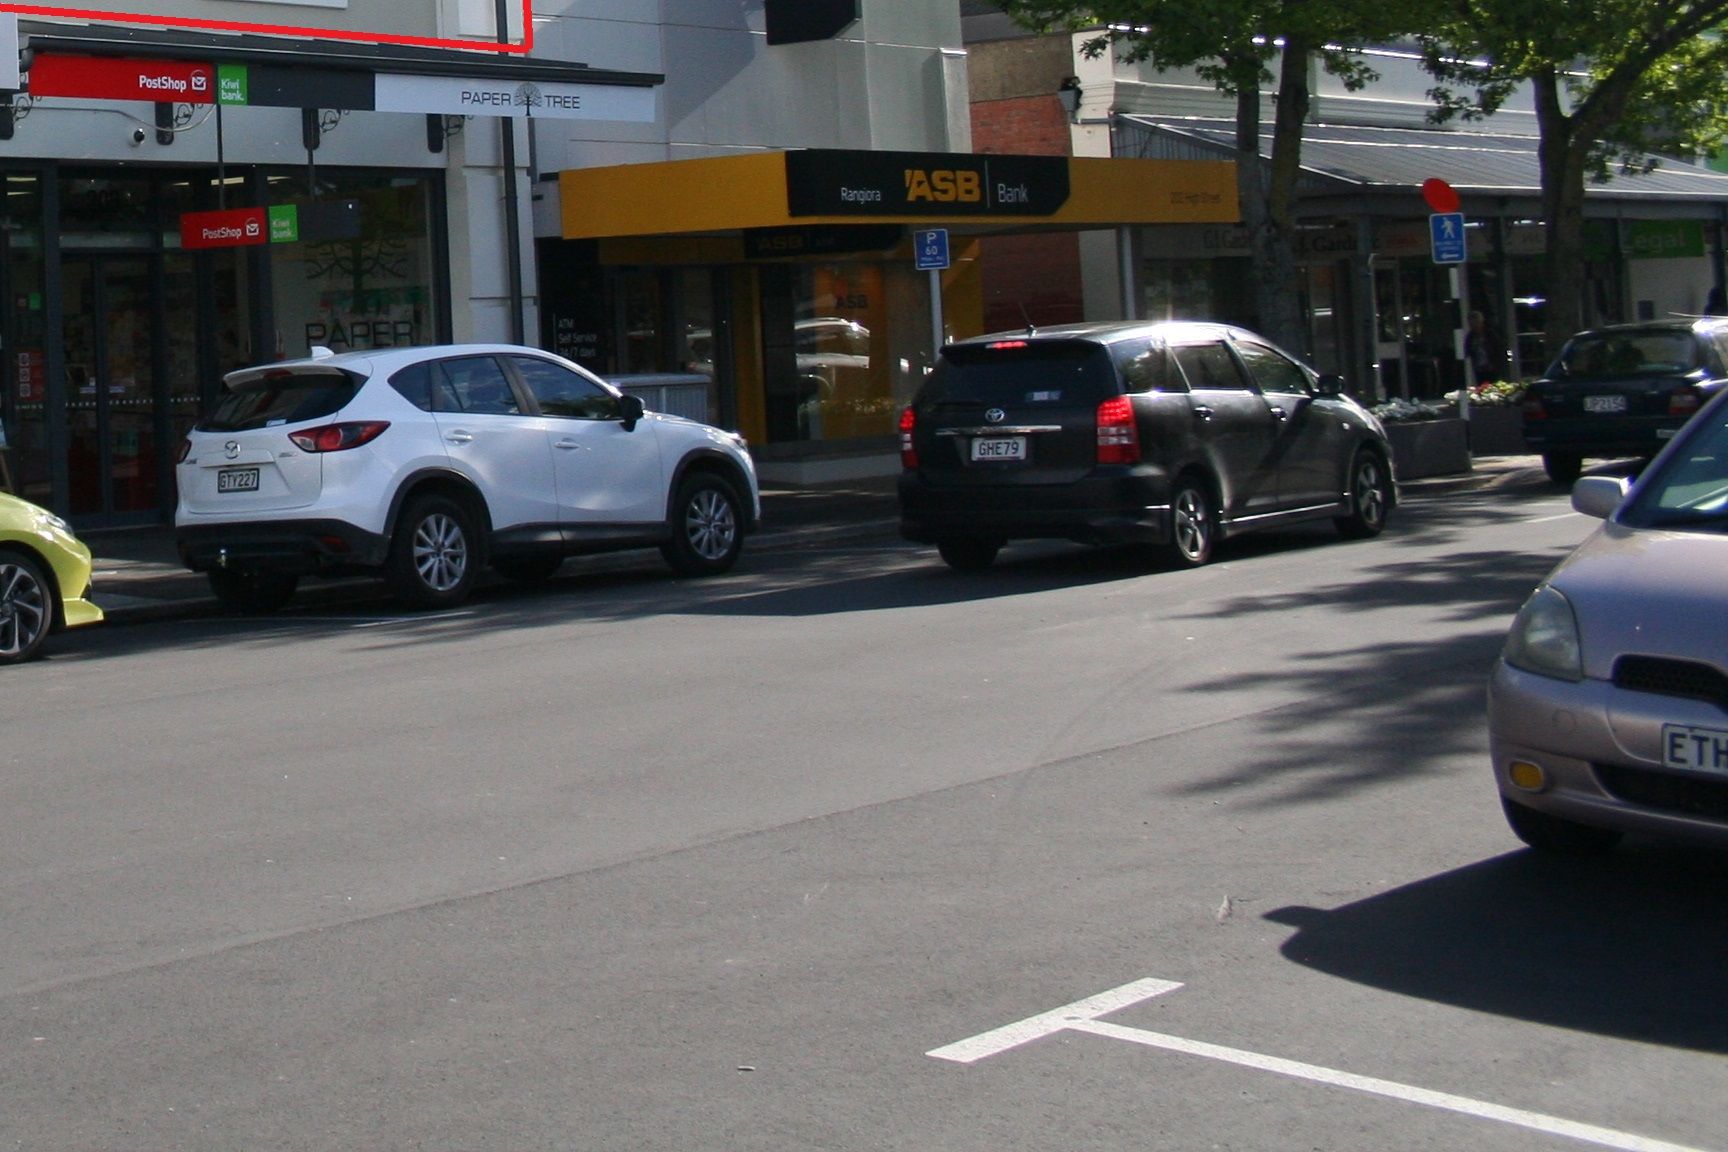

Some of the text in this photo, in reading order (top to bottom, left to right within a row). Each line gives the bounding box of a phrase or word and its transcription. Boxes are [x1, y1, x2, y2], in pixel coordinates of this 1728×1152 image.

[139, 75, 187, 92] PostShop
[222, 78, 240, 89] Kiwi
[461, 91, 581, 109] PAPER TREE
[841, 169, 1029, 204] Rangiora ASB Bank
[202, 226, 242, 240] PostShop
[927, 232, 936, 244] P
[925, 245, 938, 255] 60
[306, 322, 412, 348] PAPER
[979, 442, 1020, 456] GHE79
[220, 472, 257, 488] GTY227
[1669, 732, 1728, 768] ETH
